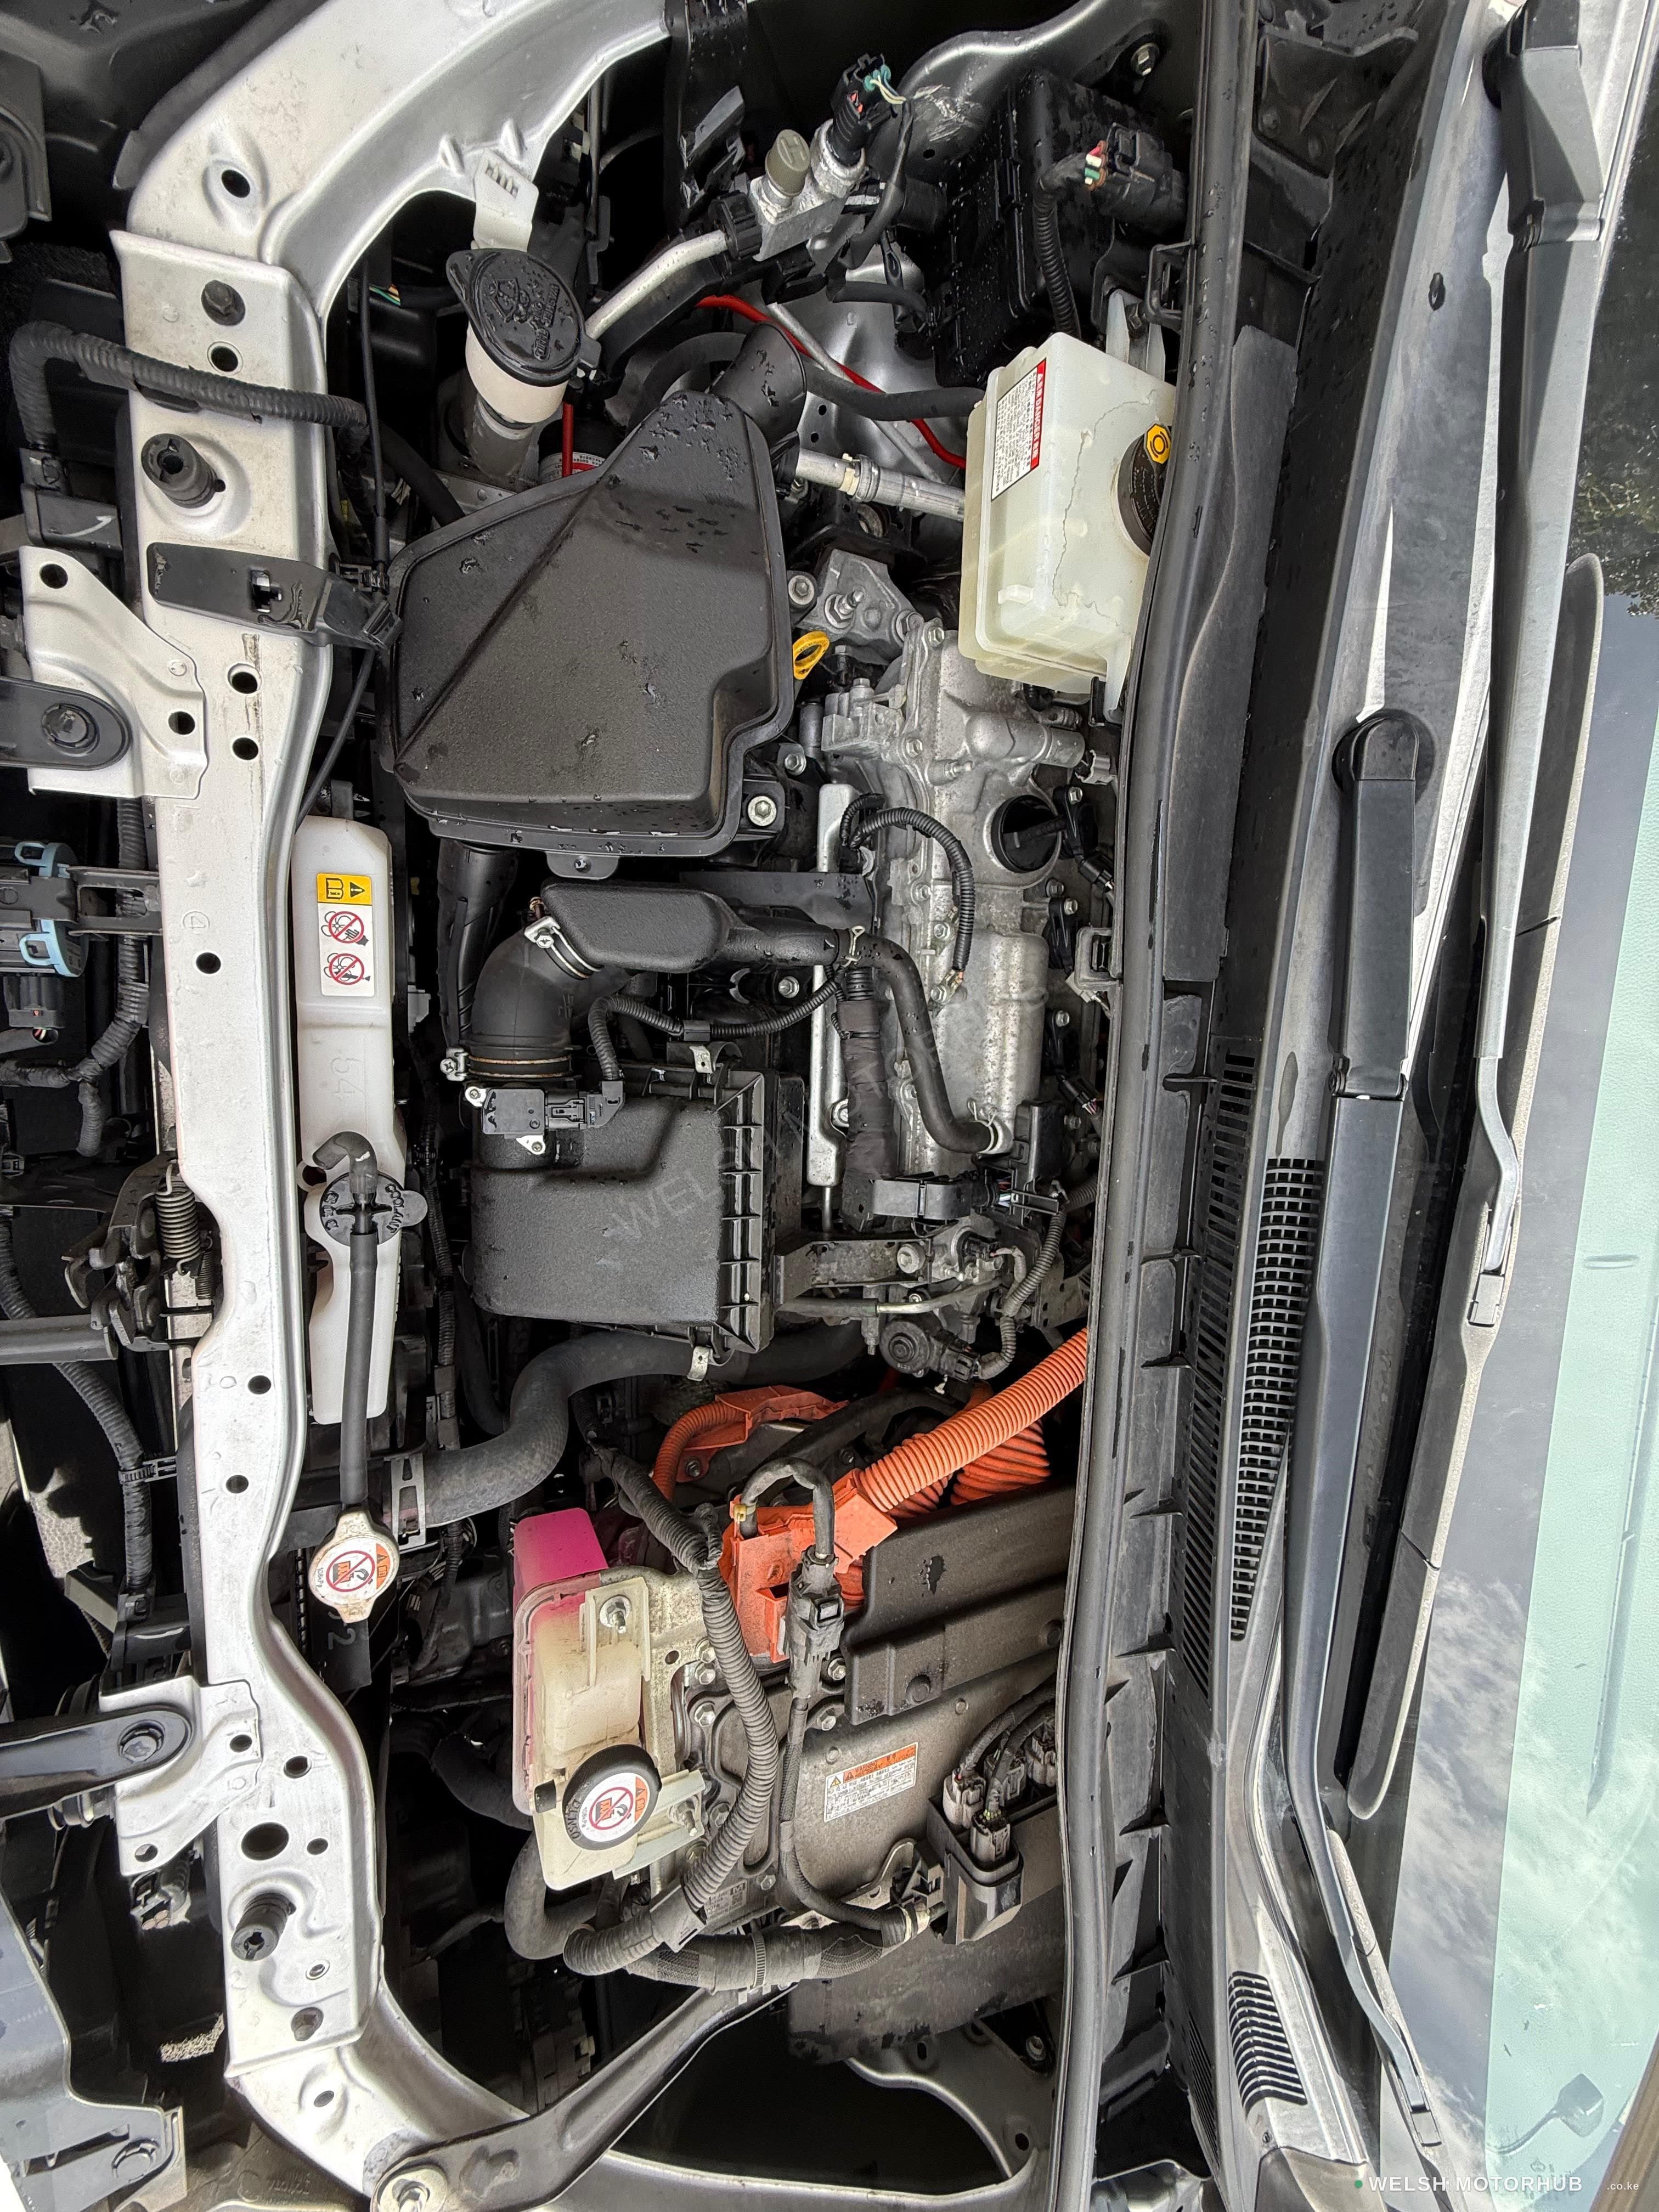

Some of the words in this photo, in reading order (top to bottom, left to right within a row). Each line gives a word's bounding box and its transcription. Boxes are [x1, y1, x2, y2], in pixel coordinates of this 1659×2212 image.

[1033, 396, 1042, 441] DANGER
[385, 1183, 404, 1233] COOLANT
[567, 1798, 582, 1839] DENSO
